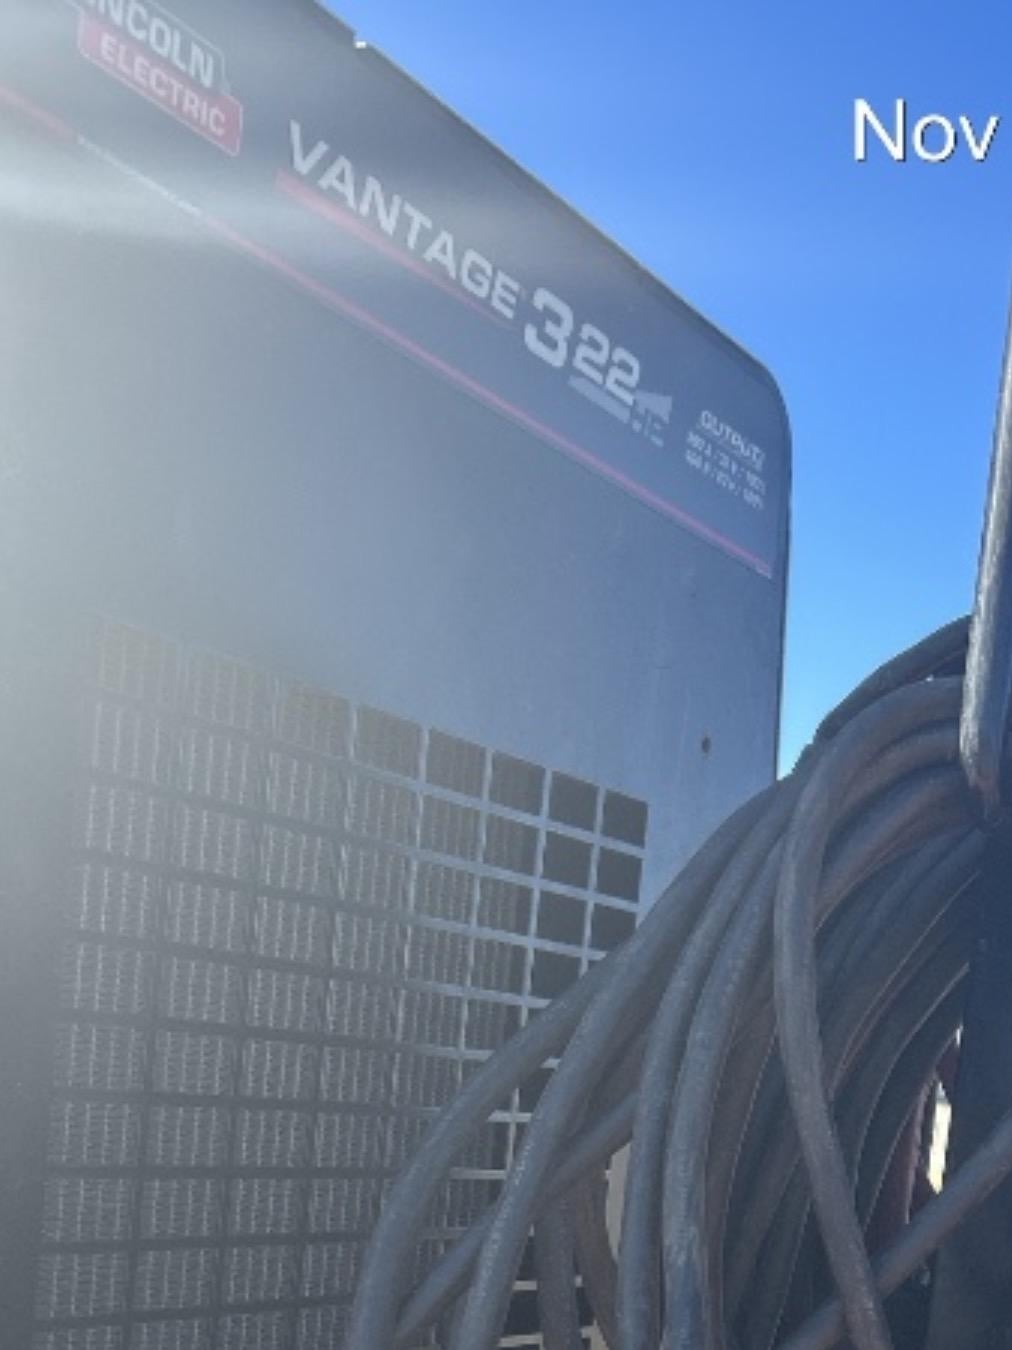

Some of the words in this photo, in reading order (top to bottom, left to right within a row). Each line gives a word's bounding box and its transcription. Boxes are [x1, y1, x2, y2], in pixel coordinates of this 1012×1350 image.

[86, 0, 213, 88] NCOLN
[99, 31, 226, 137] ELECTRIC
[289, 119, 520, 321] VANTAGE
[524, 286, 641, 406] 322
